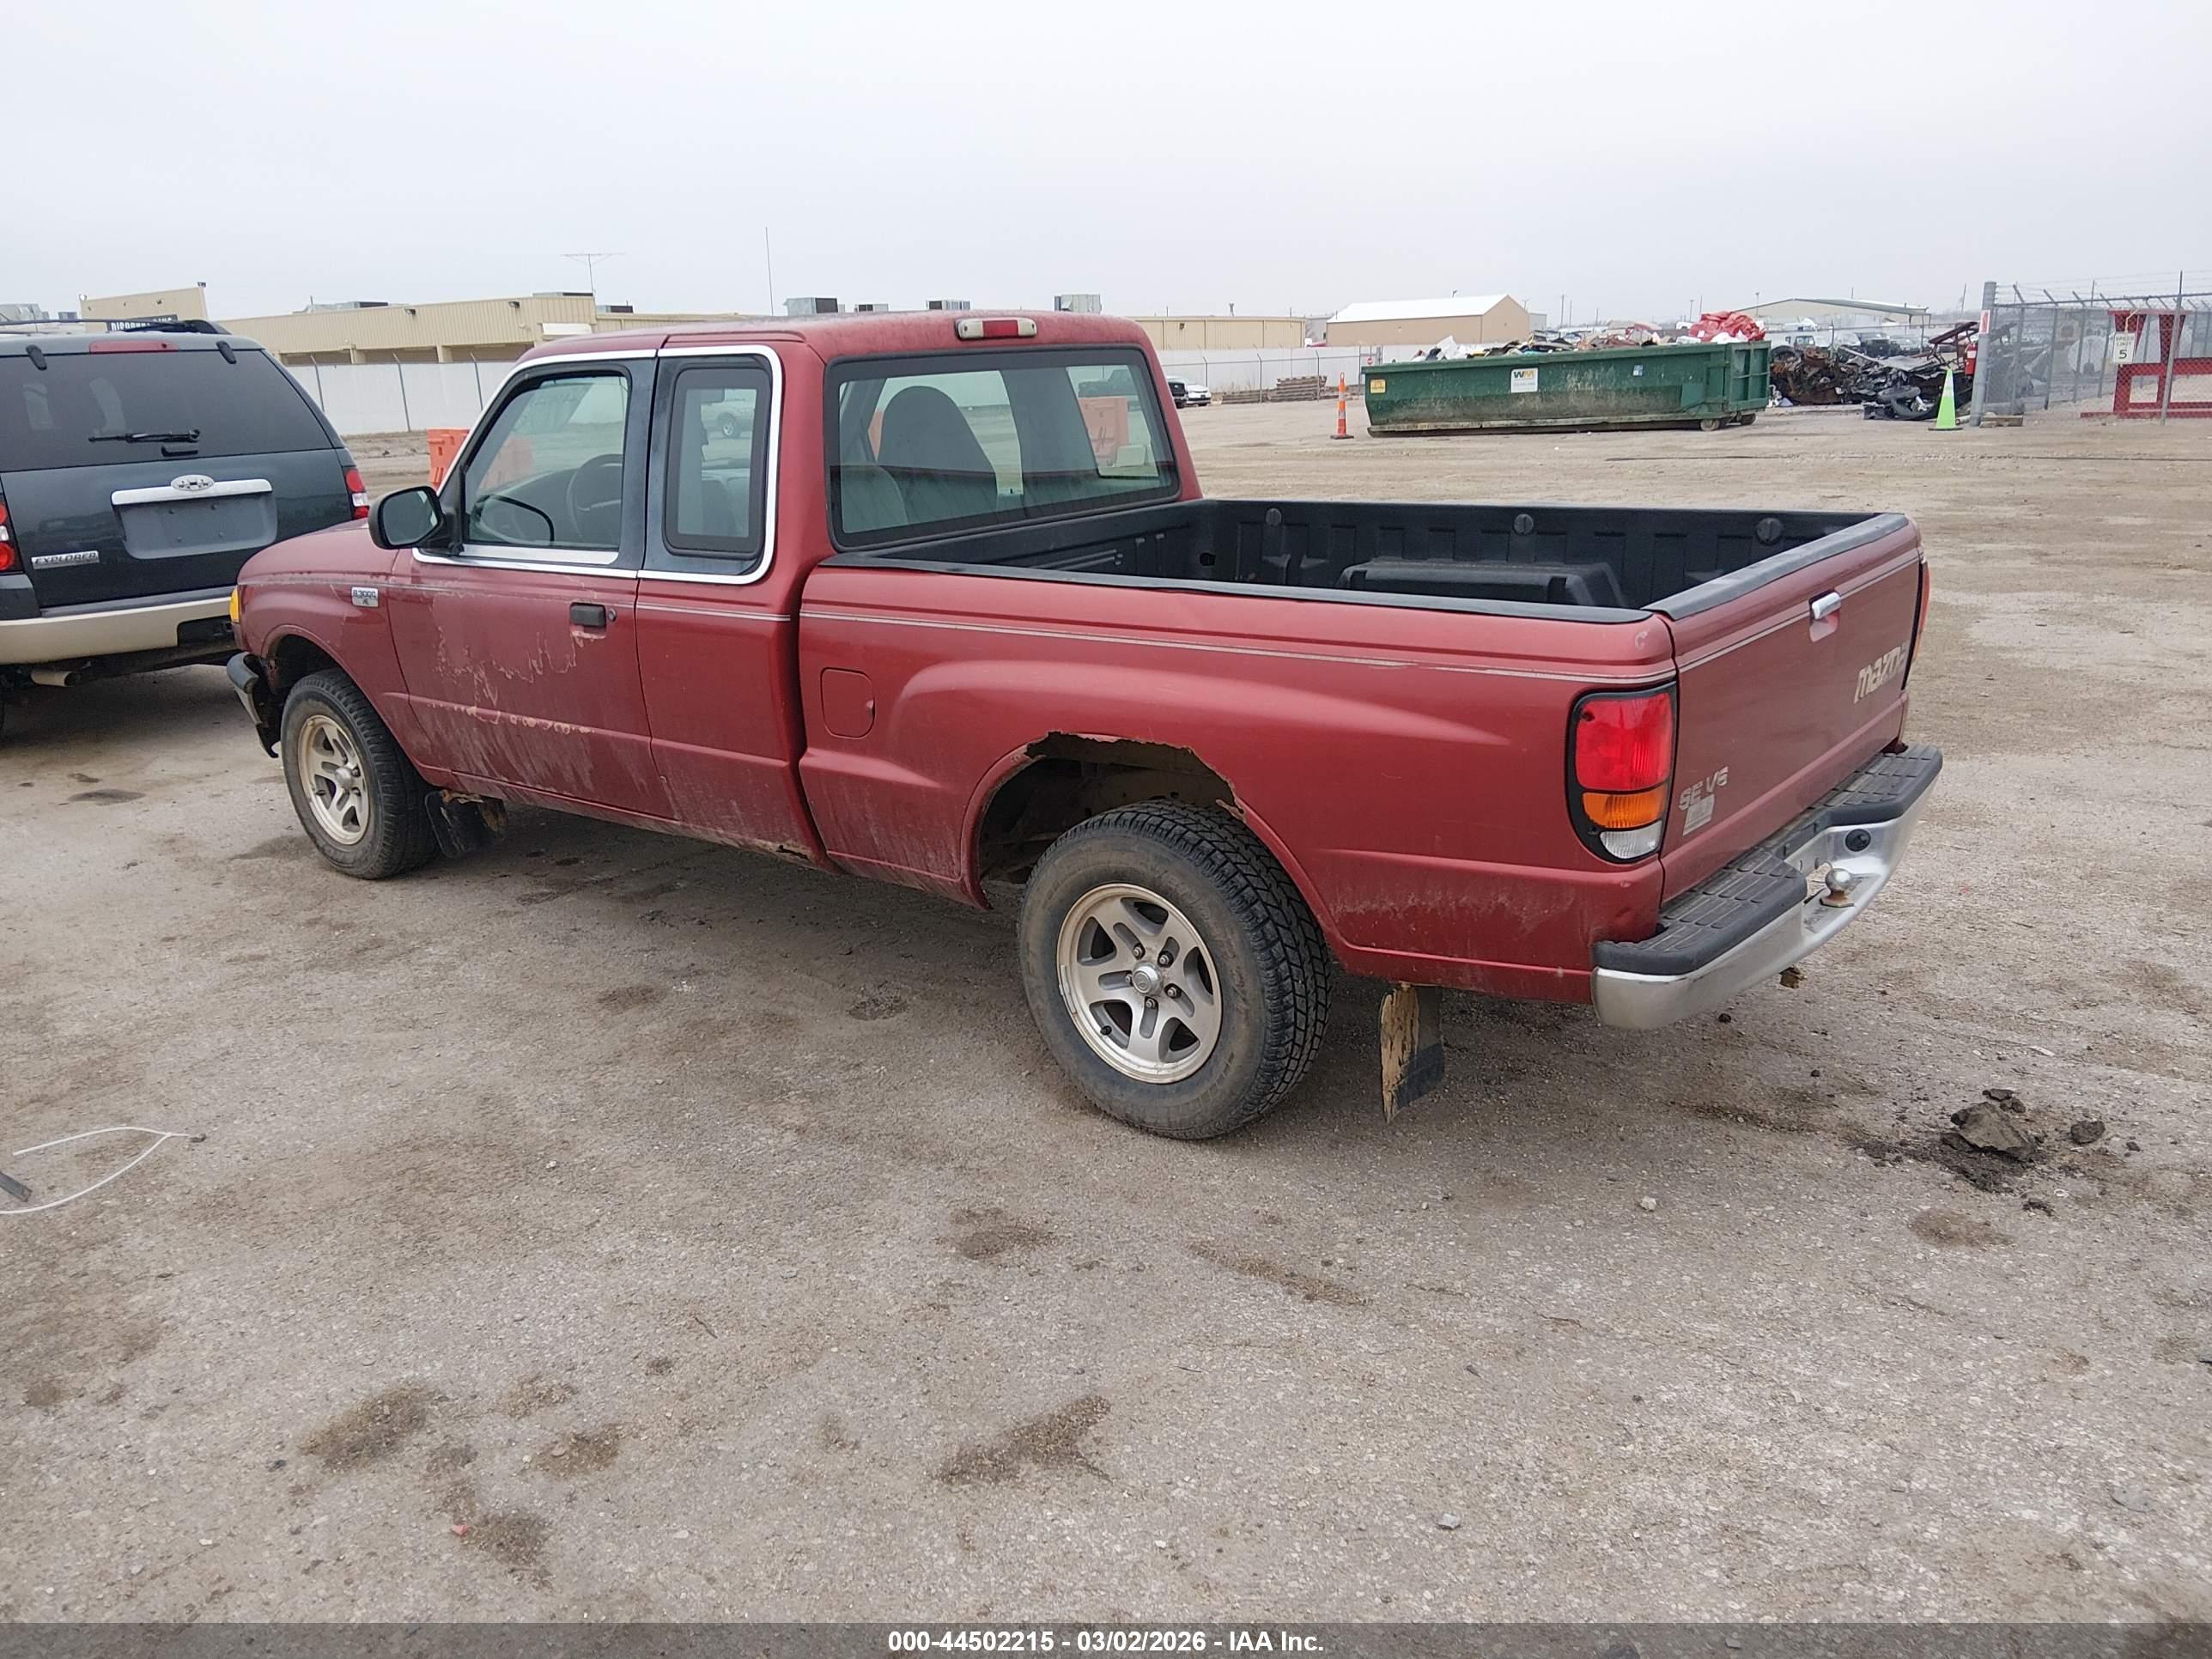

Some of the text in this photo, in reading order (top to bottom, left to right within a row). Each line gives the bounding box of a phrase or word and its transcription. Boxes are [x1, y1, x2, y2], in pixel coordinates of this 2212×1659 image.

[2118, 349, 2128, 359] 5
[34, 552, 98, 565] EXPLORER
[1679, 766, 1729, 811] SE V6
